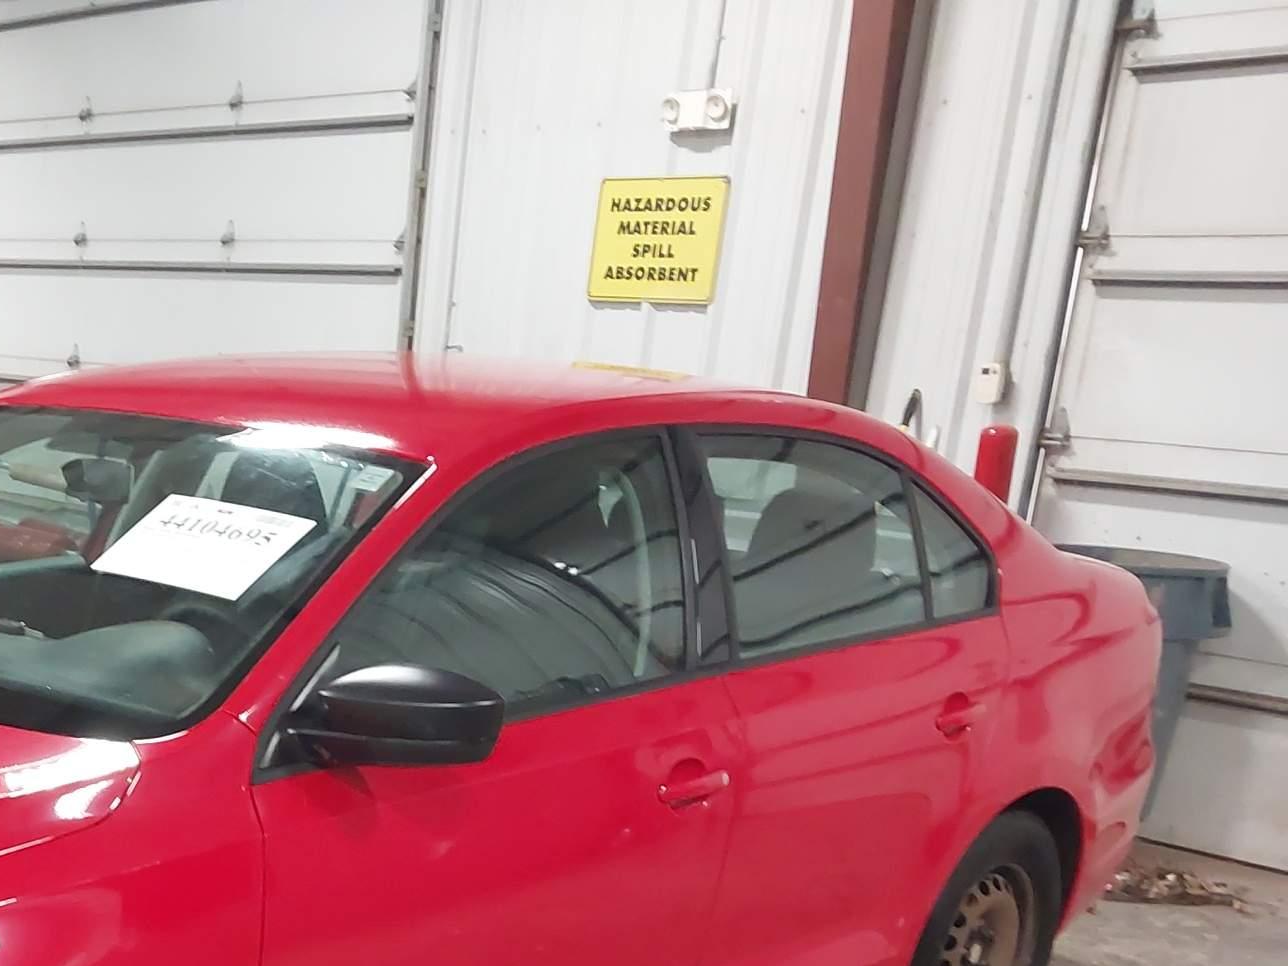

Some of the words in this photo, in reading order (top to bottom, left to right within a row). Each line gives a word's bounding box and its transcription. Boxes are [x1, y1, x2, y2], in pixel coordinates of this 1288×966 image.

[610, 196, 712, 212] HAZARDOUS
[617, 220, 696, 235] MATERIAL
[631, 243, 675, 258] SPILL
[603, 265, 699, 282] ABSORBENT
